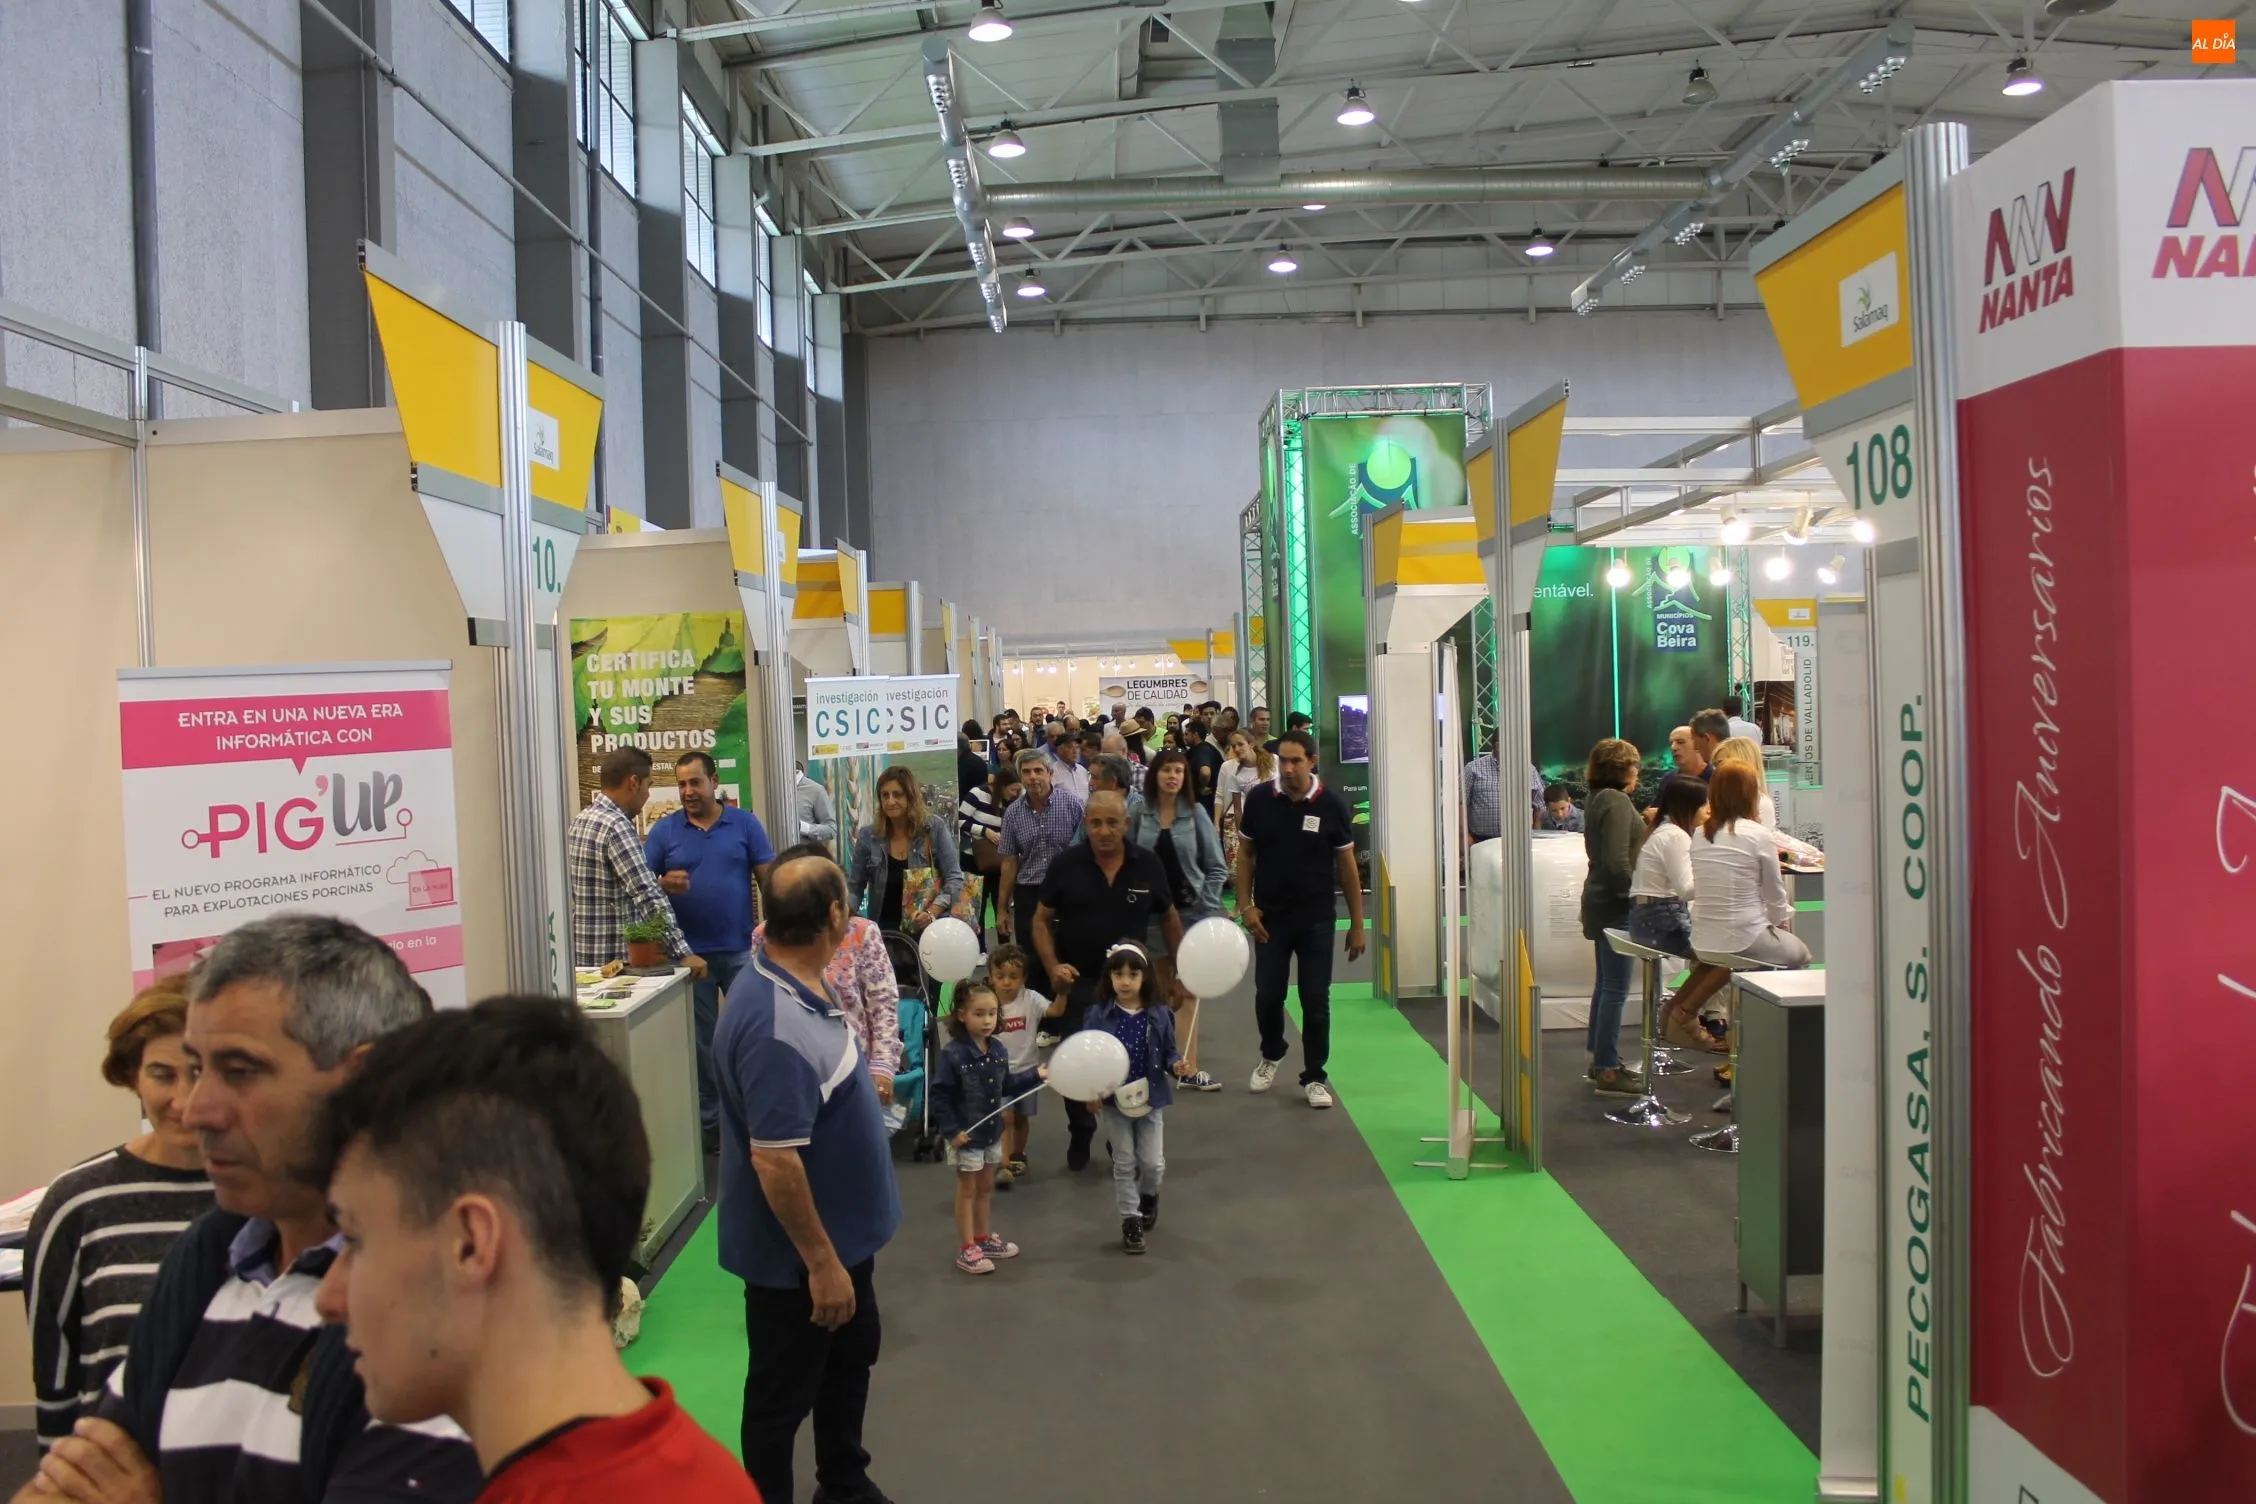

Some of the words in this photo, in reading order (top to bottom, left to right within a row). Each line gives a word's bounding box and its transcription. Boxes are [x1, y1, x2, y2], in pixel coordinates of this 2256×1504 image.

[1978, 255, 2074, 334] NANTA
[1853, 304, 1889, 333] Salamaq
[1846, 424, 1913, 511] 108
[533, 535, 561, 593] 10.
[1657, 621, 1695, 635] Cova
[1657, 635, 1697, 648] Beira
[1787, 635, 1815, 648] 119.
[586, 649, 695, 673] CERTIFICA
[587, 680, 614, 700] TU
[622, 676, 695, 698] MONTE
[1127, 679, 1188, 689] LEGUMBRES
[1127, 690, 1141, 700] DE
[1143, 689, 1188, 700] CALIDAD
[1803, 658, 1813, 725] VALLADOLID
[2014, 455, 2069, 929] Aniversarios
[816, 689, 879, 706] investigación
[178, 710, 239, 728] ENTRA
[242, 708, 267, 724] EN
[272, 707, 308, 723] UNA
[313, 705, 367, 721] NUEVA
[371, 703, 404, 719] ERA
[588, 707, 602, 726] Y
[610, 705, 652, 726] SUS
[815, 707, 881, 738] CSIC
[216, 728, 333, 750] INFORMÁTICA
[336, 728, 372, 744] CON
[590, 728, 717, 753] PRODUCTOS
[1804, 728, 1813, 742] DE
[1900, 695, 1927, 900] COOP.
[152, 889, 171, 901] EL
[174, 883, 221, 898] NUEVO
[224, 874, 297, 893] PROGRAMA
[300, 864, 382, 883] INFORMÁTICO
[164, 904, 200, 918] PARA
[204, 890, 309, 913] EXPLOTACIONES
[312, 882, 374, 899] PORCINAS
[407, 938, 422, 948] en
[1905, 946, 1929, 1004] S.
[2018, 944, 2074, 1378] Fabricando
[1906, 1029, 1931, 1424] PECOGASA,
